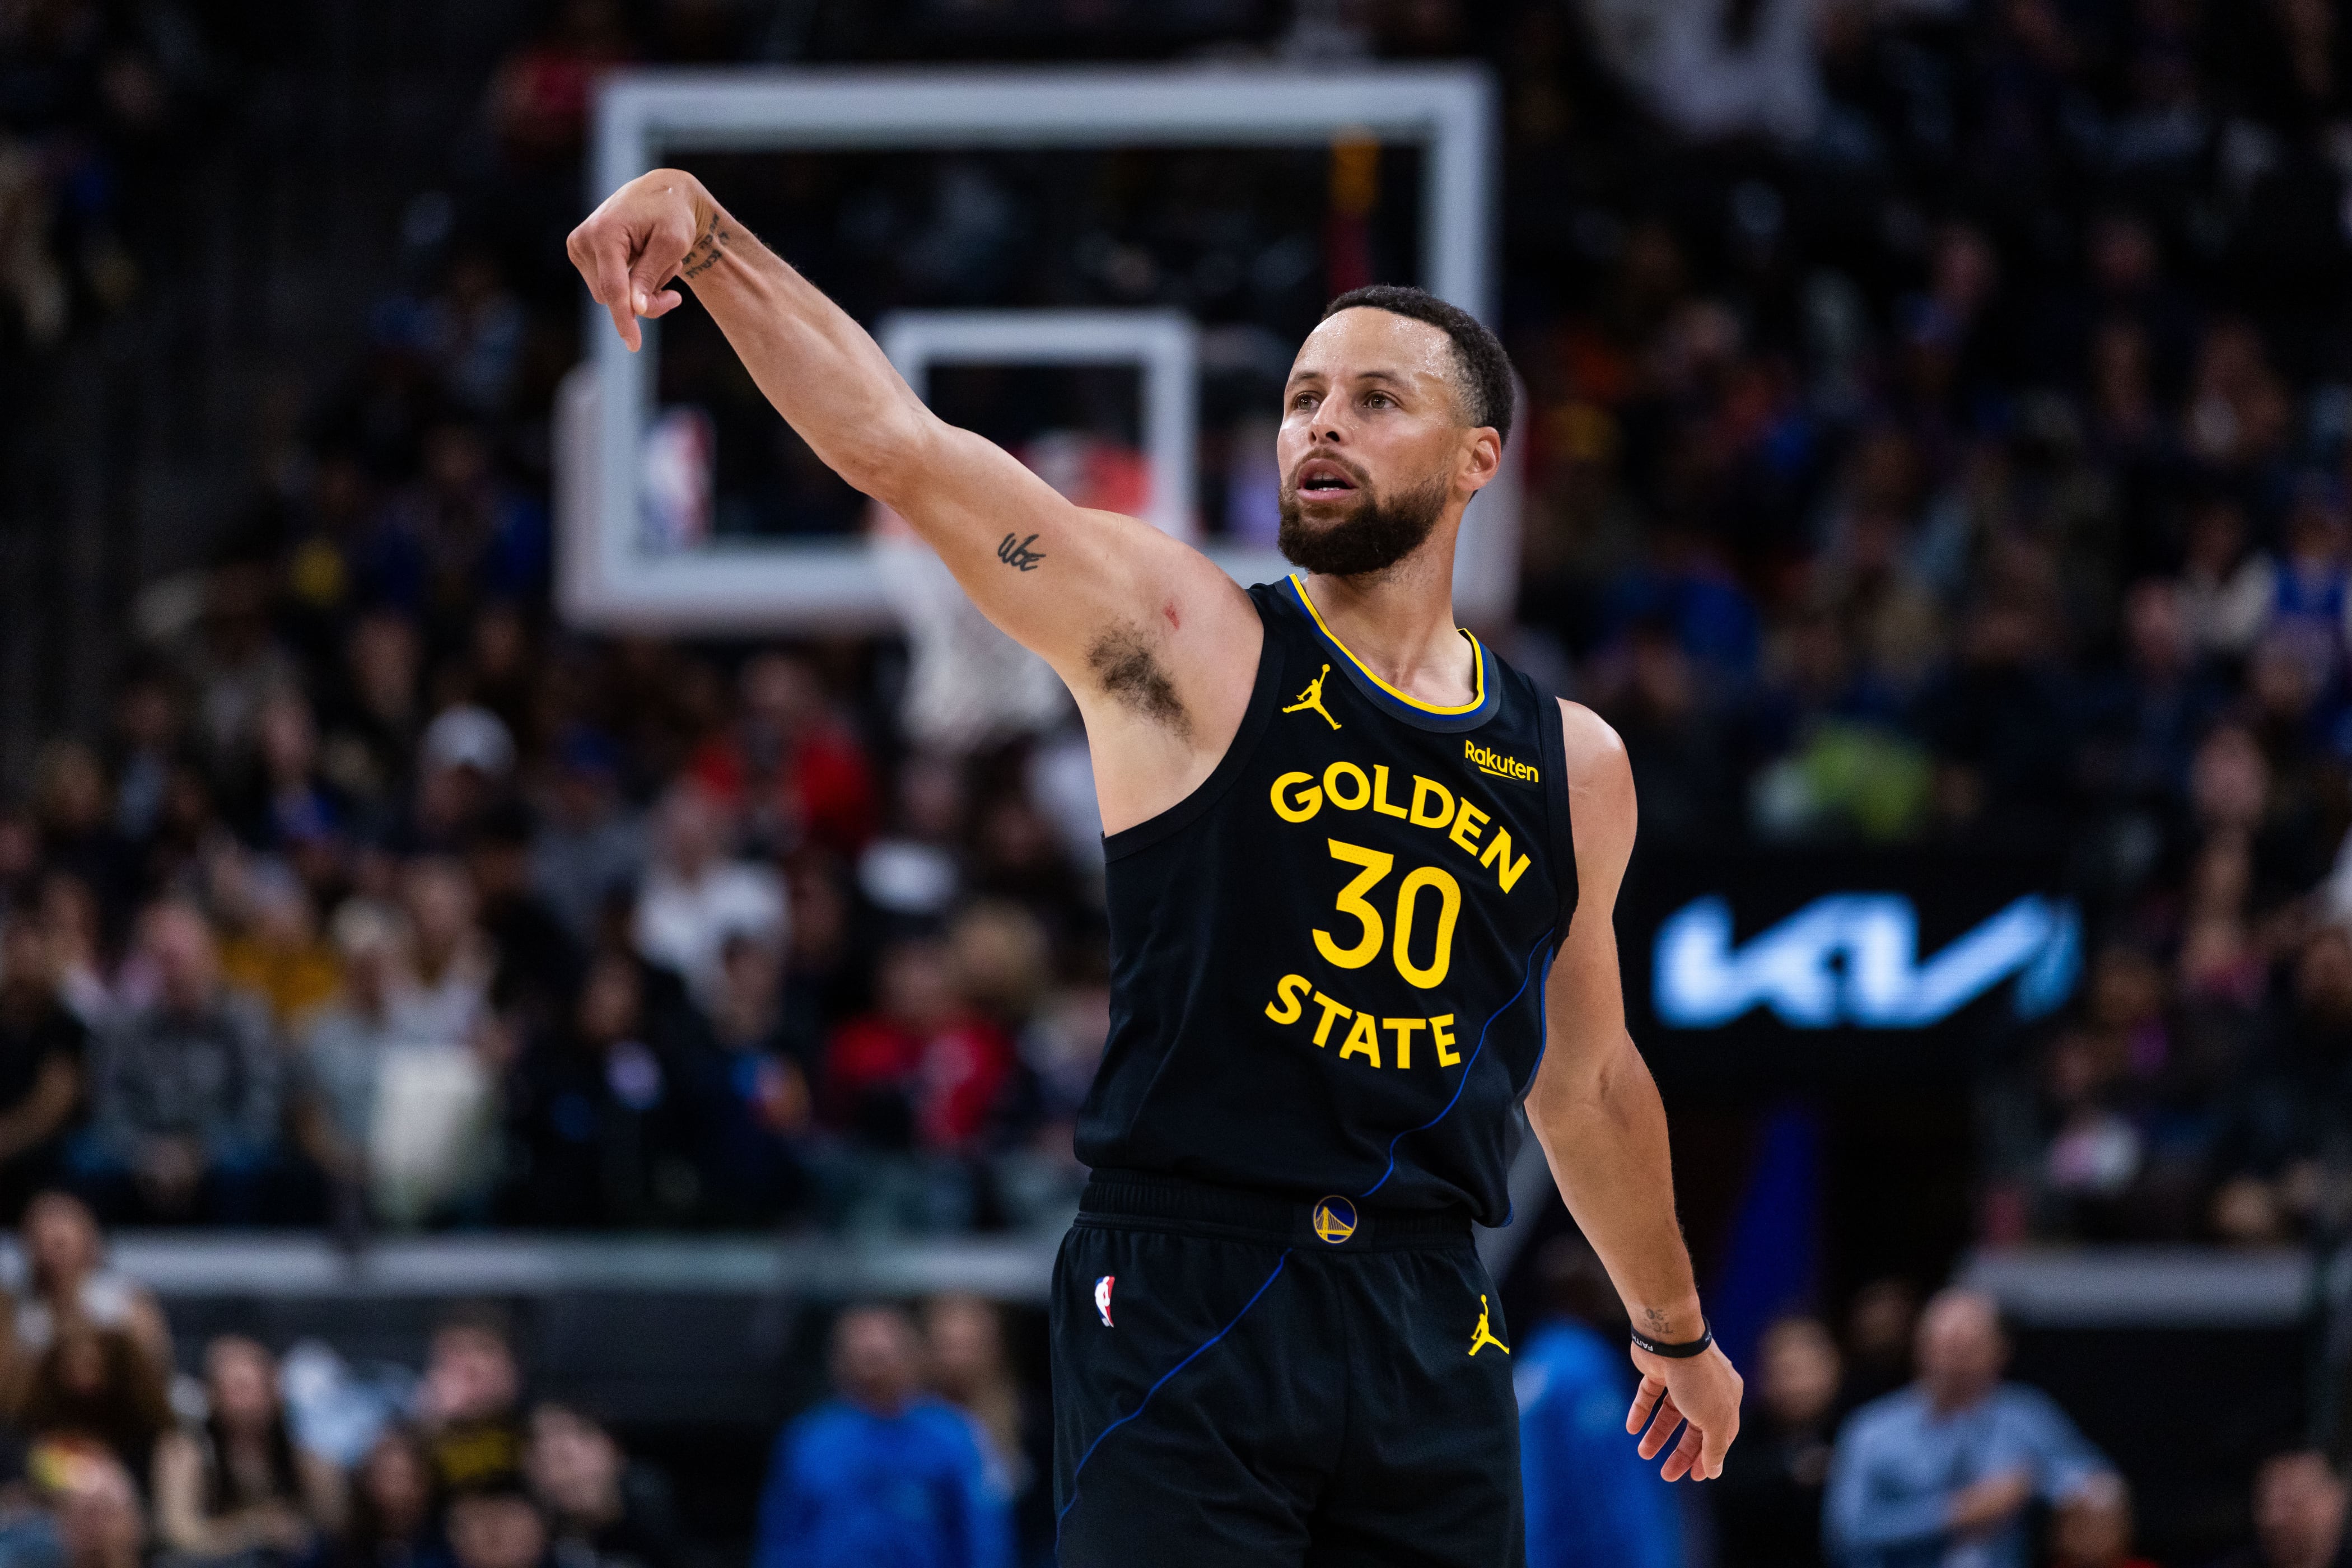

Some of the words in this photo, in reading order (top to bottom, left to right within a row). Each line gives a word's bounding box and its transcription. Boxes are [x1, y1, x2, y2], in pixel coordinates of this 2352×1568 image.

[1464, 739, 1539, 783] Rakuten
[1270, 761, 1532, 894] GOLDEN
[1312, 837, 1462, 989] 30
[1264, 974, 1461, 1069] STATE
